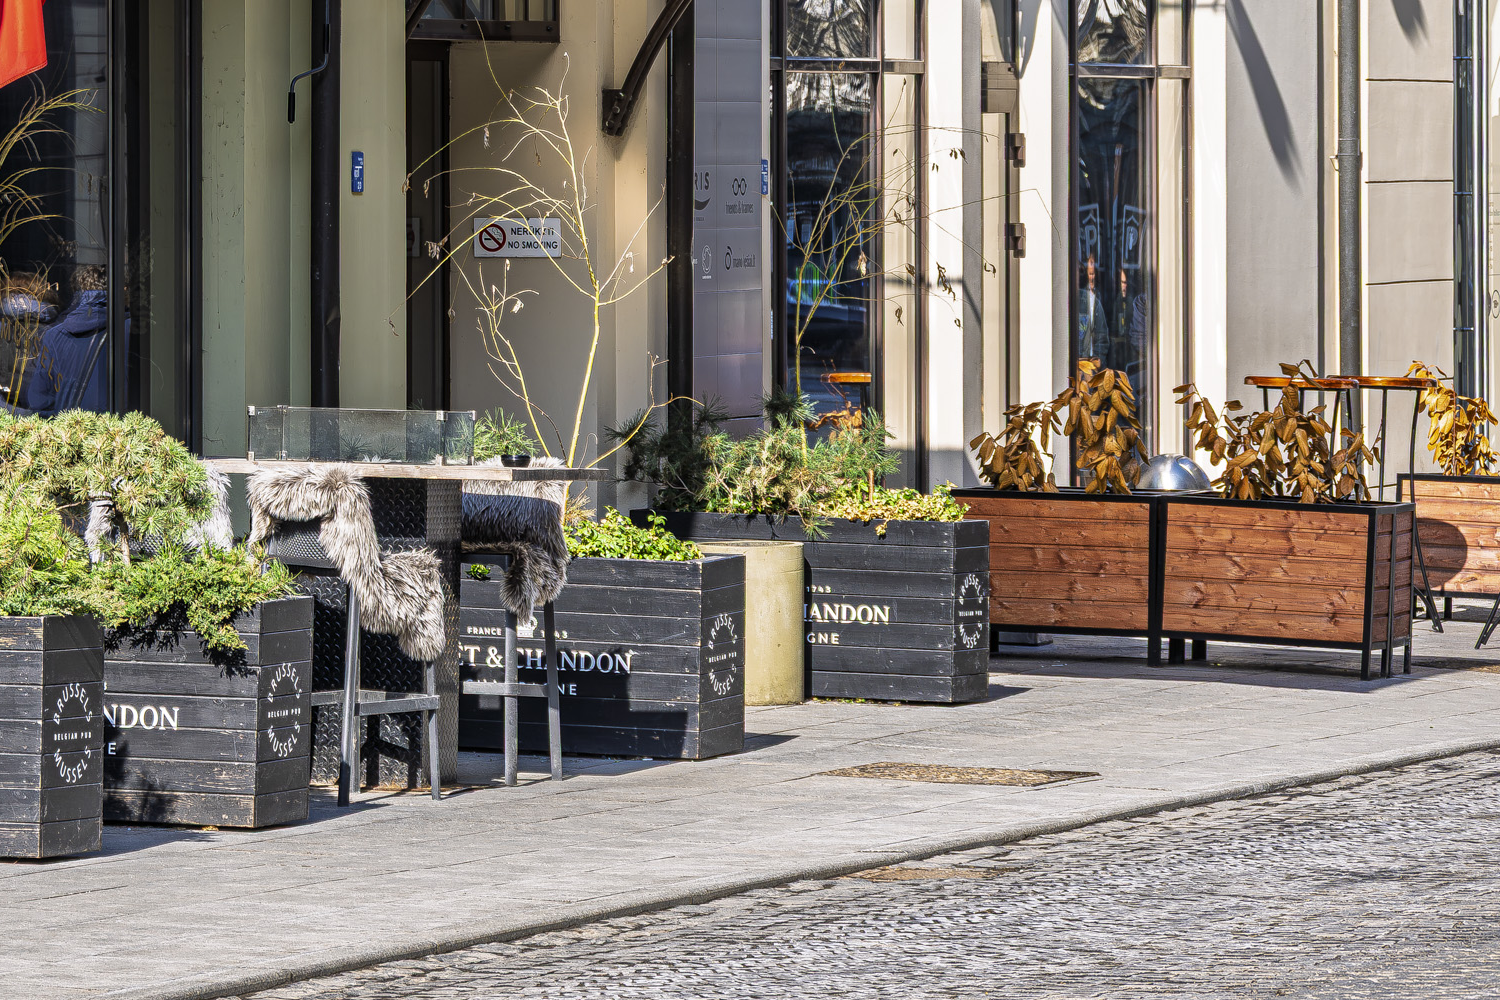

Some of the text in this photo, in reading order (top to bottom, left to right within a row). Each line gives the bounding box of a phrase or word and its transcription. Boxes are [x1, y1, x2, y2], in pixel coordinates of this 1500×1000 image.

[507, 241, 558, 249] NO SMOING
[806, 585, 832, 594] 1743
[466, 625, 569, 640] FRANCE 143
[485, 645, 504, 668] &
[516, 647, 634, 675] HNDON
[267, 662, 303, 703] BRUSSELS
[53, 682, 93, 725] BRUSSELS
[53, 731, 92, 741] BELGIAN PUB
[267, 721, 301, 757] MUSSELS
[53, 745, 91, 784] MUSSELS
